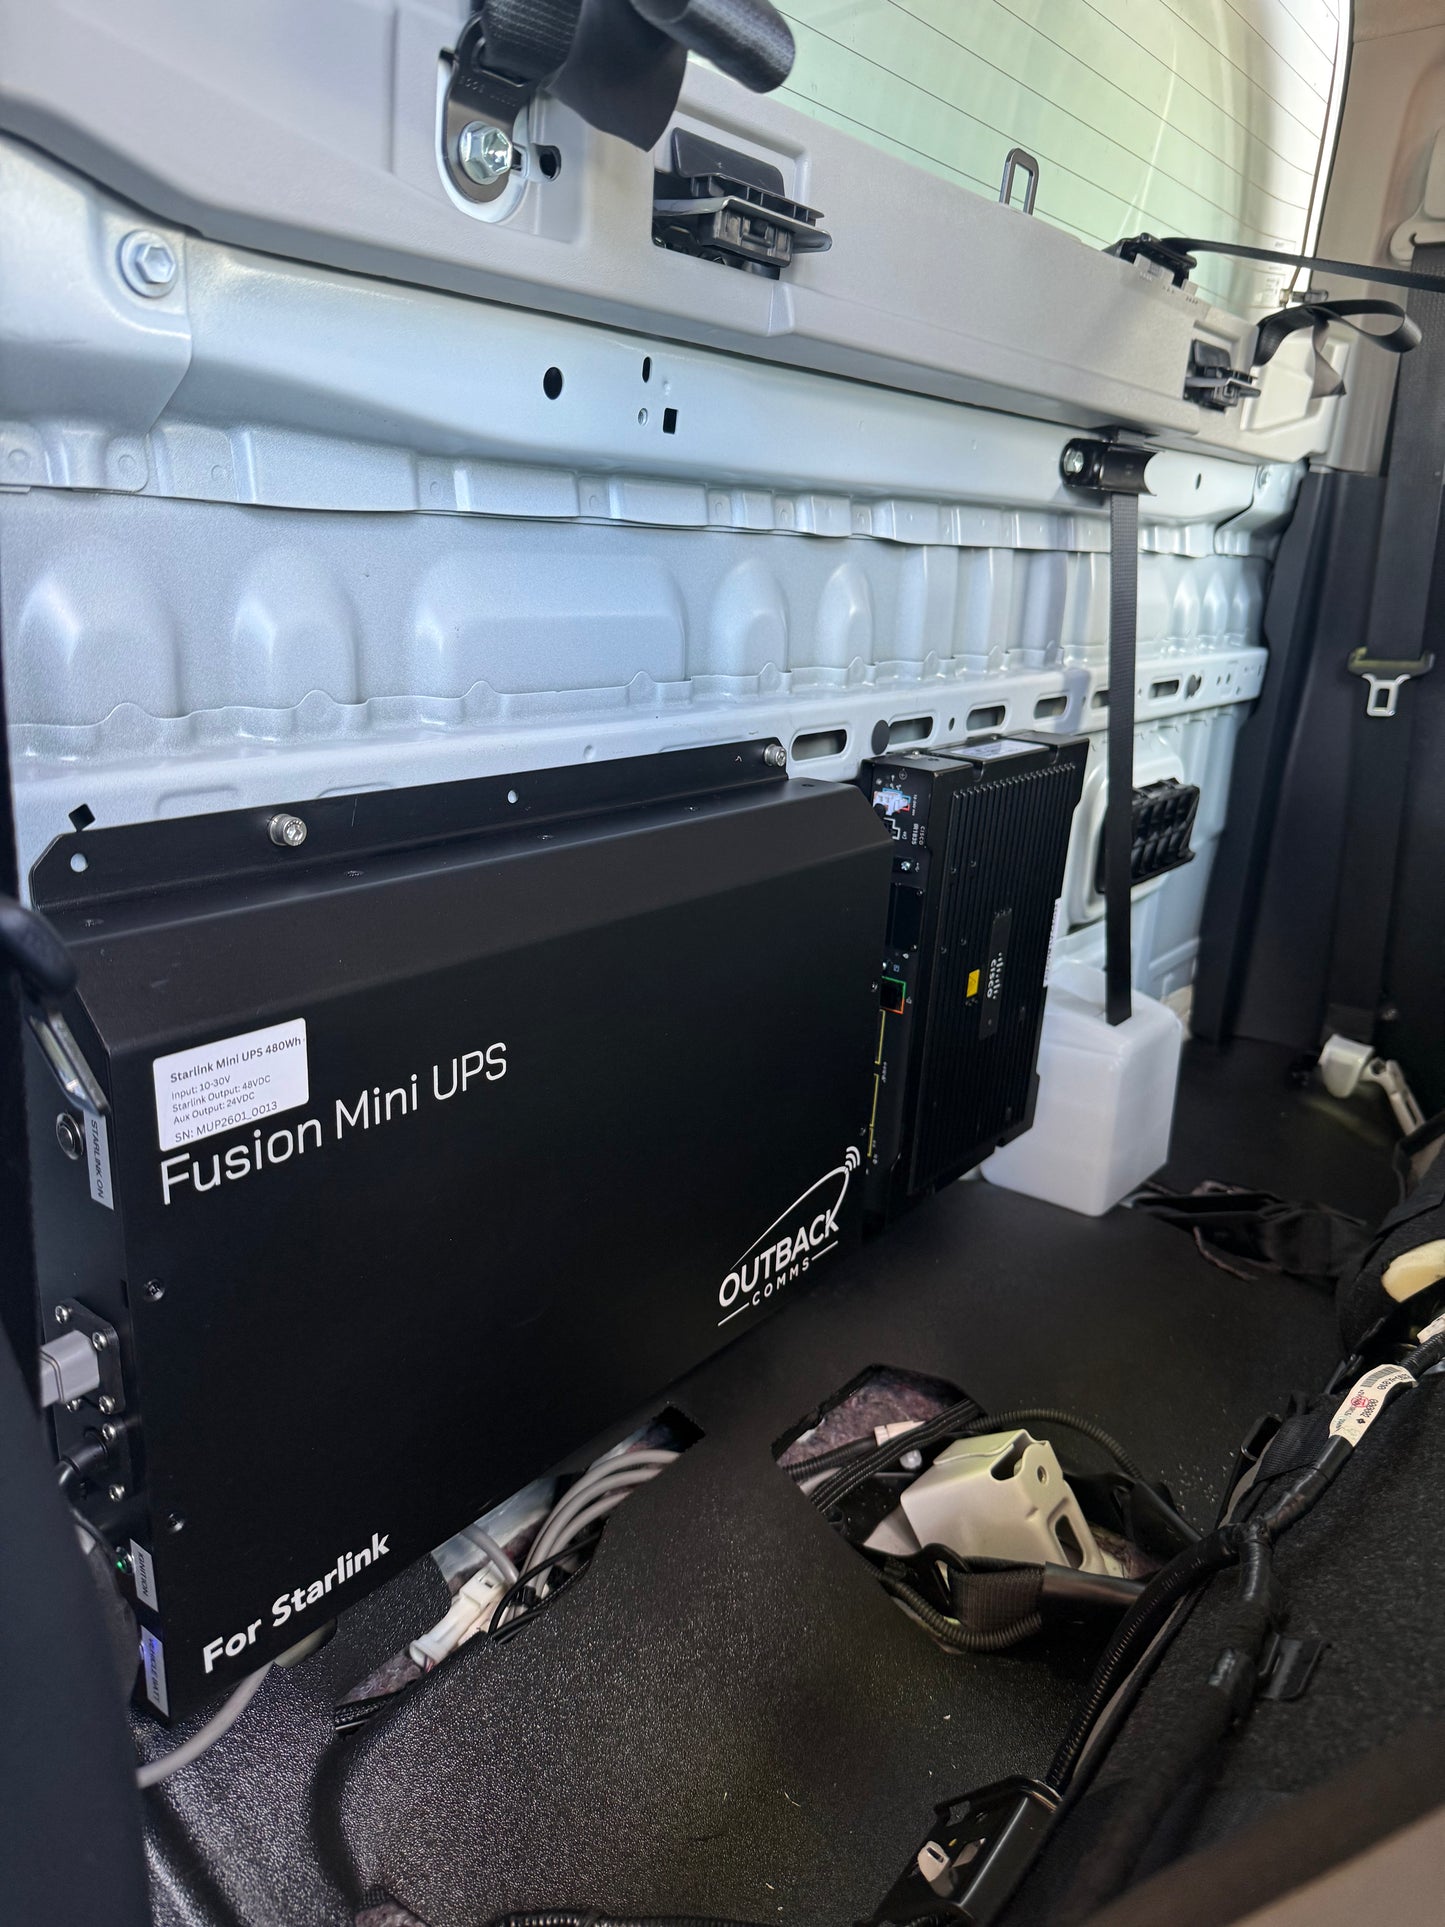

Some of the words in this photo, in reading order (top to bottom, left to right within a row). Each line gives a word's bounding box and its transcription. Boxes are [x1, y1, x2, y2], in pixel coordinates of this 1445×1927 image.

[986, 959, 996, 998] cisco
[170, 1062, 214, 1083] Starlink
[216, 1054, 239, 1070] Mini
[241, 1047, 263, 1062] UPS
[265, 1036, 301, 1055] 480Wh
[171, 1086, 198, 1100] Input:
[200, 1075, 231, 1092] 10-30V
[172, 1094, 206, 1113] Starlink
[208, 1085, 240, 1102] Output:
[242, 1075, 271, 1090] 48VDC
[173, 1113, 190, 1125] Aux
[192, 1101, 225, 1118] Output:
[226, 1092, 255, 1108] 24VDC
[160, 1118, 322, 1205] Fusion
[335, 1073, 419, 1140] Mini
[432, 1041, 507, 1101] UPS
[175, 1129, 194, 1143] SN:
[196, 1101, 278, 1136] MUP2601_0013
[91, 1120, 103, 1178] STARLINK
[96, 1180, 104, 1199] ON
[718, 1209, 840, 1307] OUTBACK
[752, 1257, 810, 1306] COMMS
[138, 1552, 149, 1597] IGNITION
[202, 1618, 262, 1674] For
[271, 1532, 390, 1627] Starlink
[149, 1638, 159, 1679] VEHICLE
[152, 1678, 161, 1703] BATT
